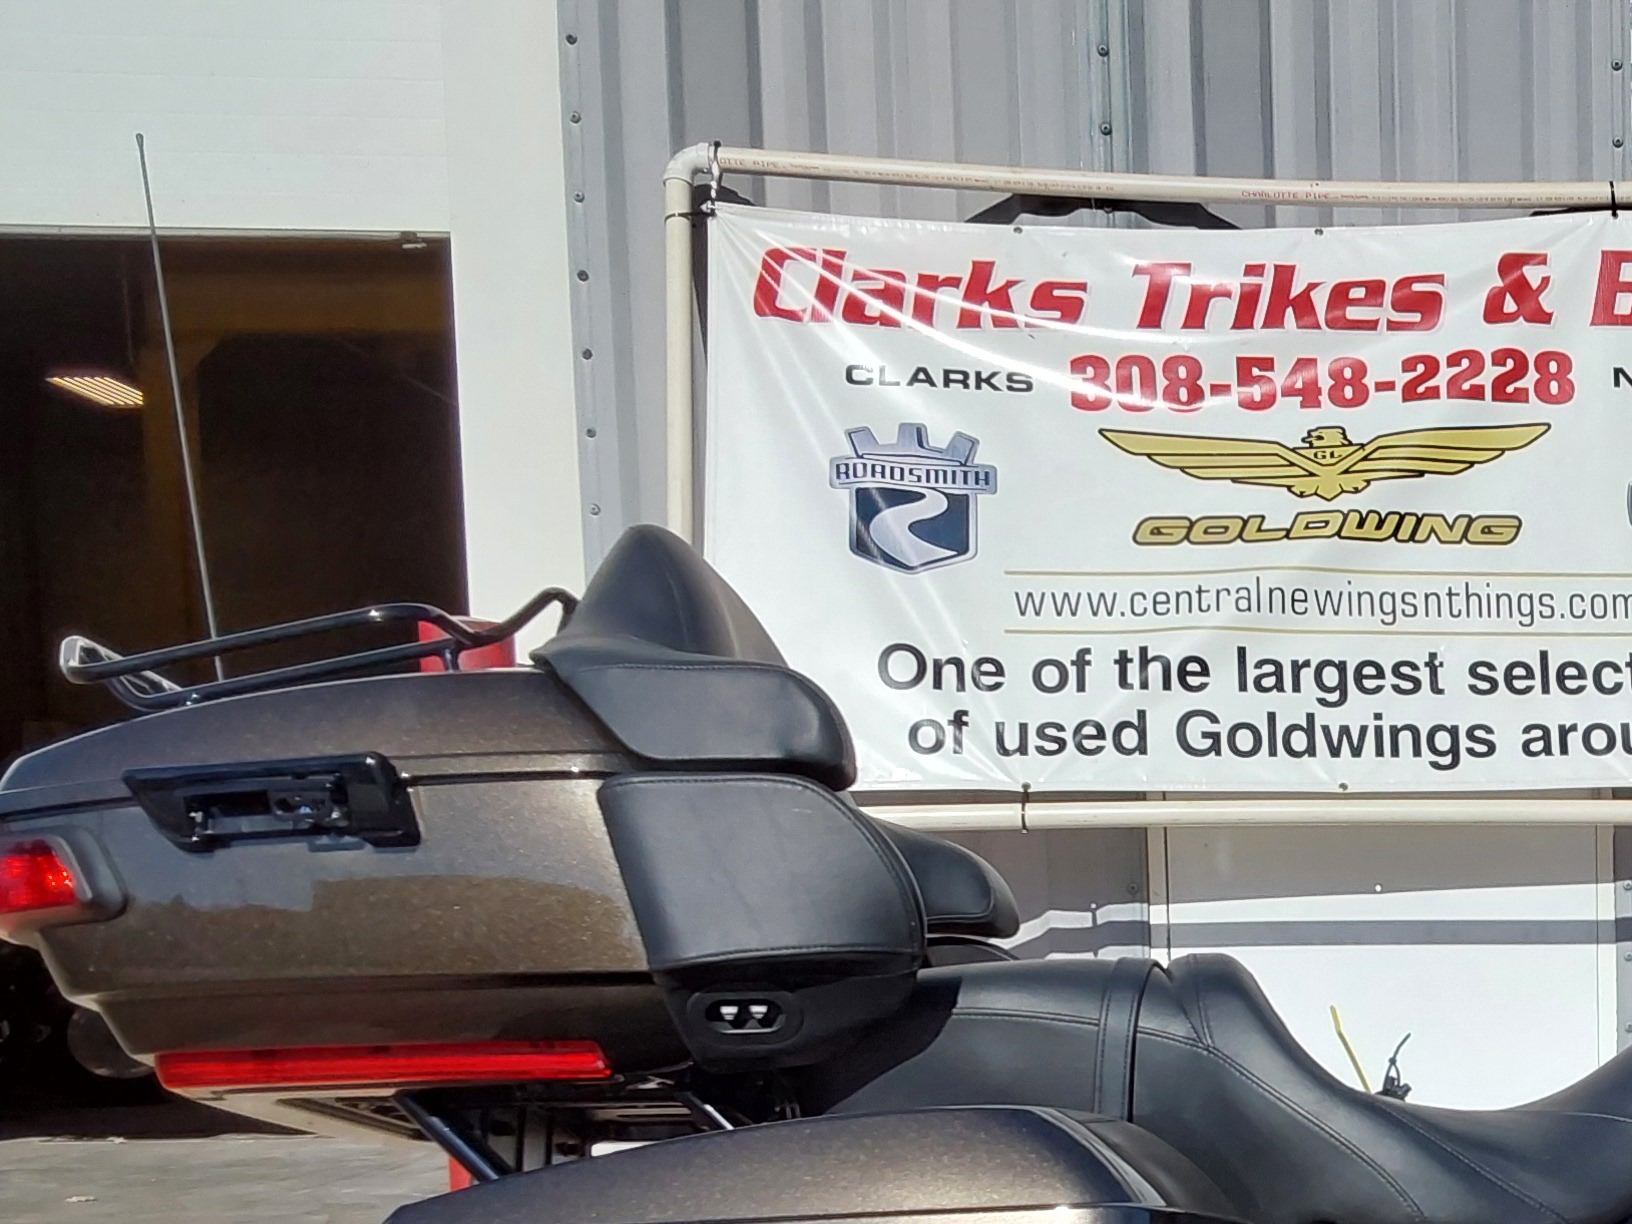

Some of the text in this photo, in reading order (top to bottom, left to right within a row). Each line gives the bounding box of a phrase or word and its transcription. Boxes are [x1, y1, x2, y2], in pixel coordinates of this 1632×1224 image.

[752, 245, 1089, 331] Clarks
[1131, 261, 1446, 332] Trikes
[1481, 251, 1555, 327] &
[844, 362, 1034, 393] CLARKS
[1069, 348, 1576, 412] 308-548-2228
[835, 462, 990, 486] ROADSMITH
[1313, 450, 1343, 460] GL
[1132, 509, 1523, 547] GOLDWING
[877, 642, 1006, 693] One
[1031, 646, 1093, 693] of
[1112, 644, 1211, 692] the
[1236, 644, 1446, 708] largest
[908, 709, 970, 755] of
[994, 709, 1149, 756] used
[1175, 708, 1497, 771] Goldwings
